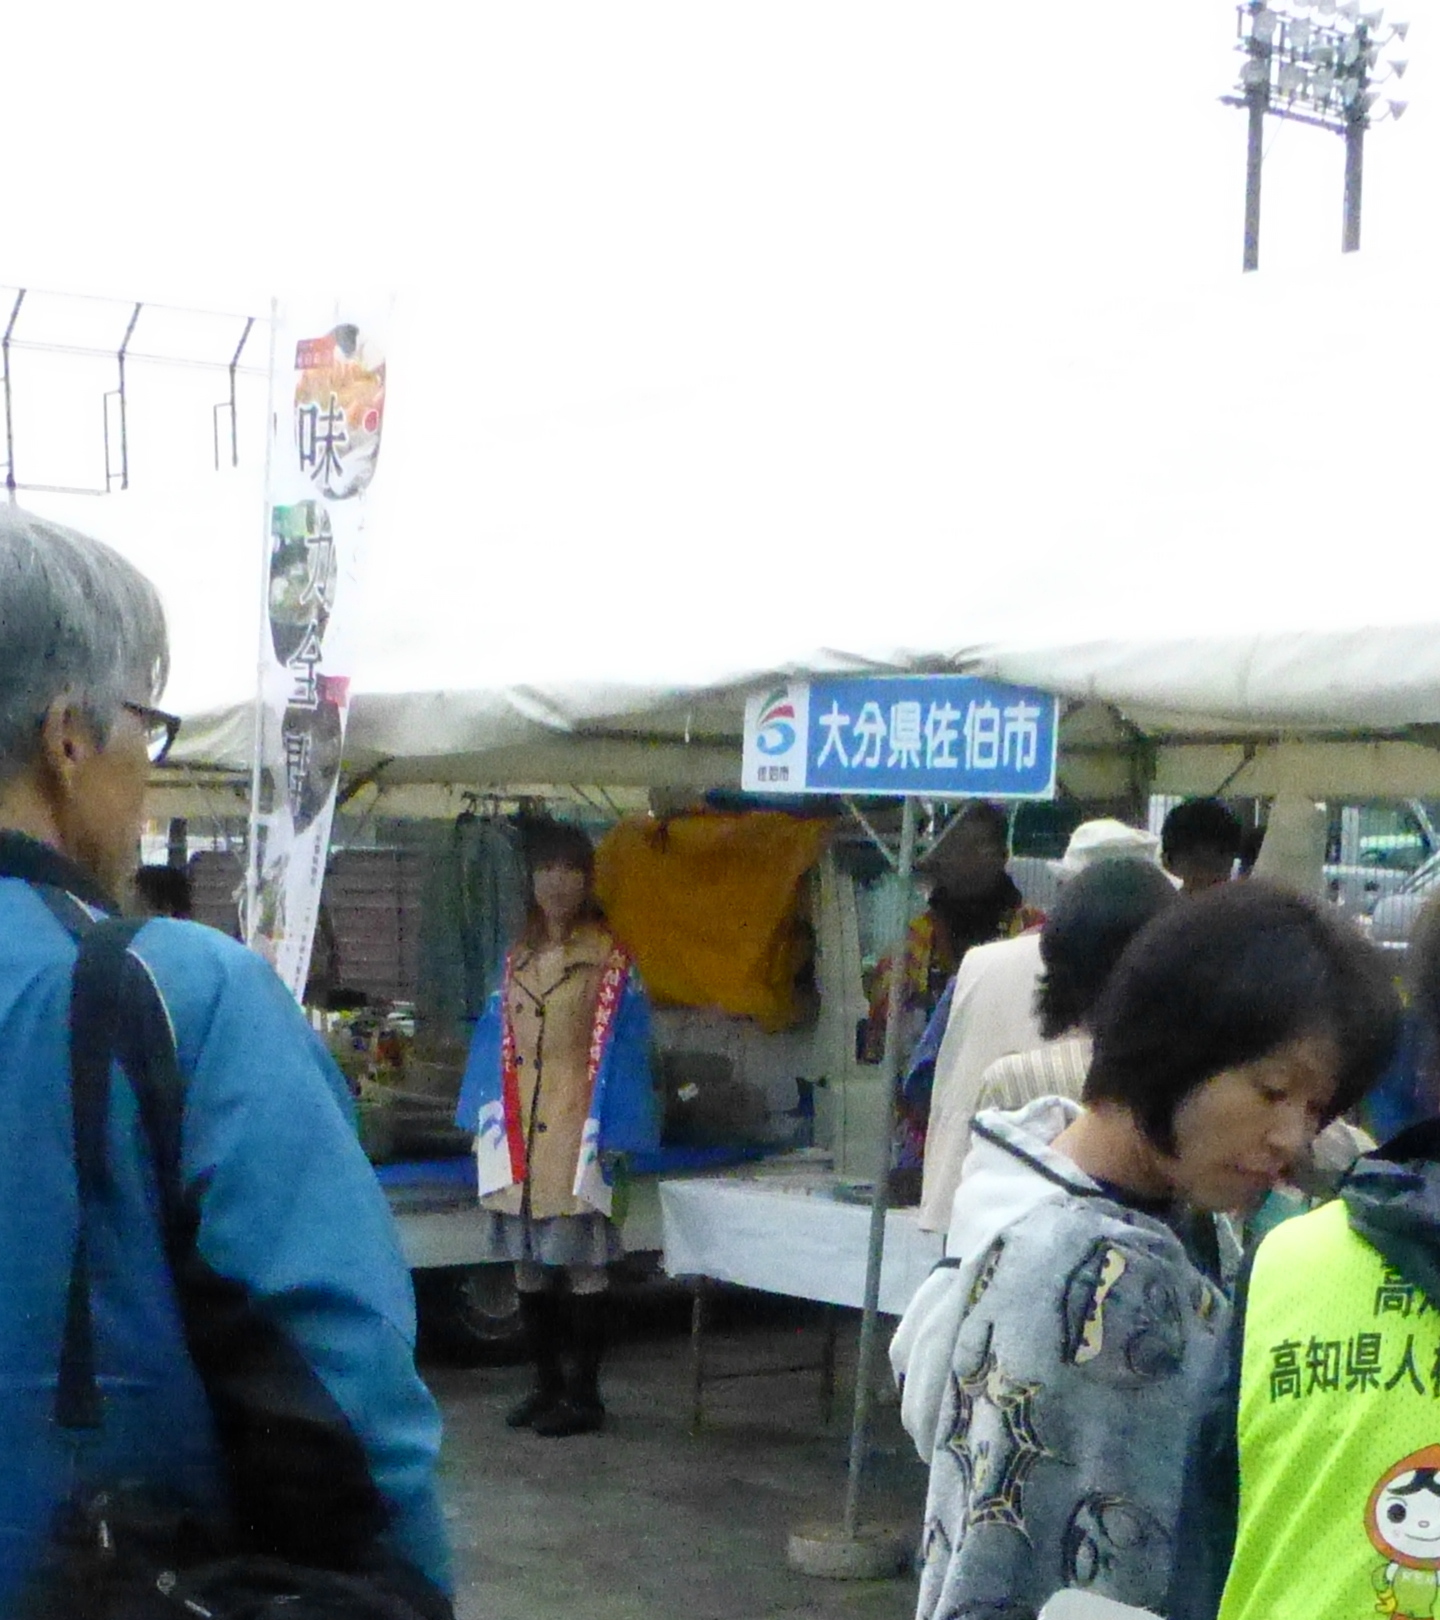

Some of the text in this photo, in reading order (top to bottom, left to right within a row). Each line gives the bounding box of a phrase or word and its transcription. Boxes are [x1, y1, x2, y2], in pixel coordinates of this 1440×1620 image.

[817, 699, 1041, 772] 大分県佐伯市
